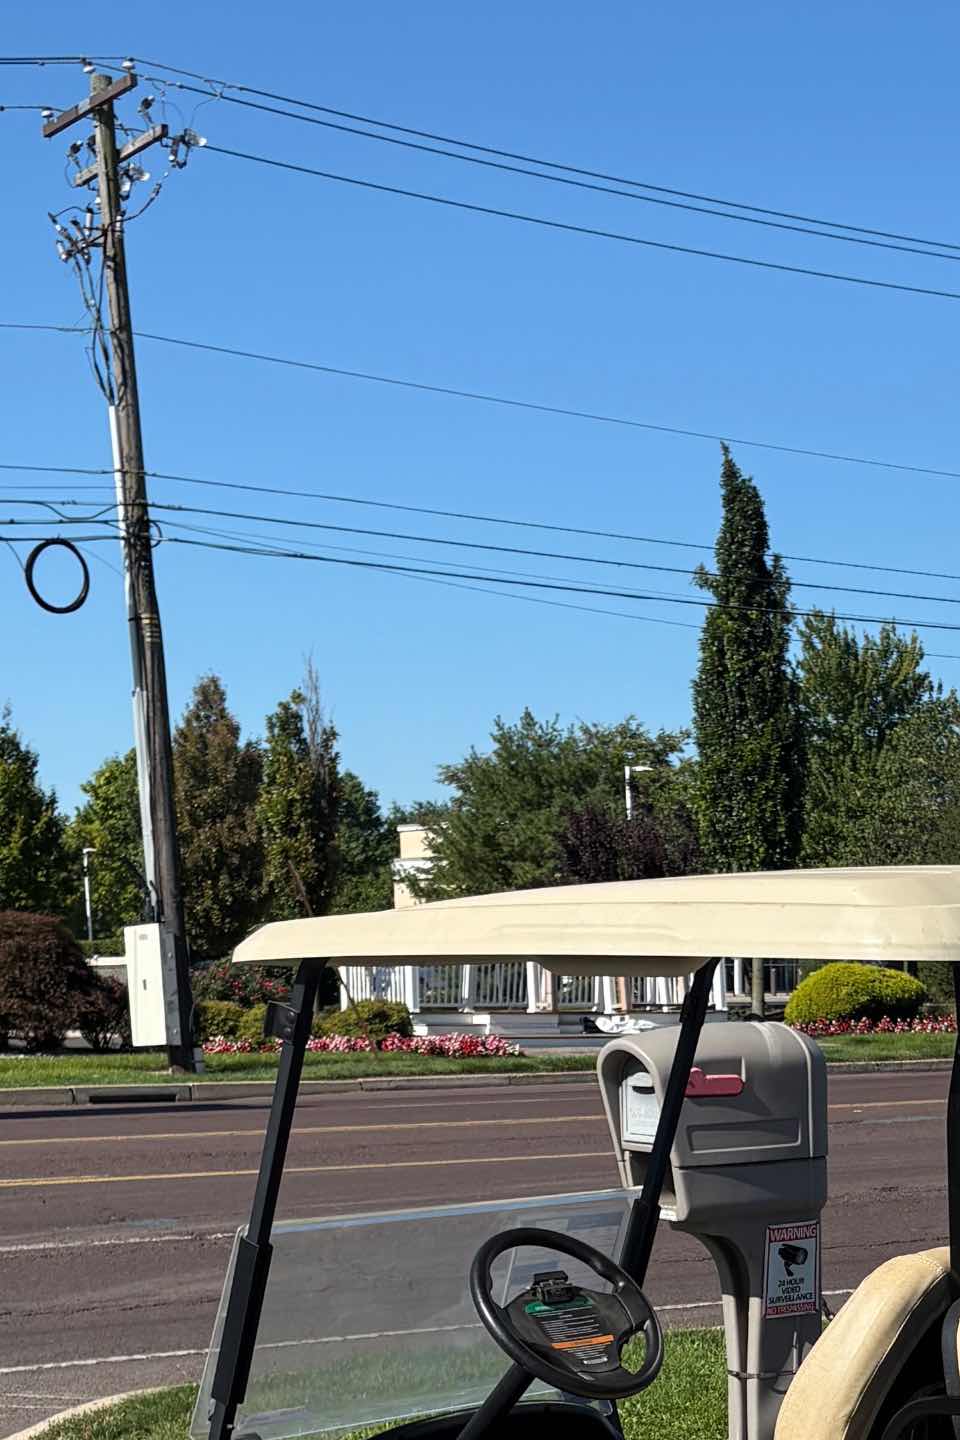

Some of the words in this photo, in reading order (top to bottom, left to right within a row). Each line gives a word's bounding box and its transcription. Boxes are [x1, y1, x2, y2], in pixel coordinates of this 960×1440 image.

[769, 1224, 817, 1241] WARNING
[786, 1277, 804, 1286] HOUR
[782, 1285, 802, 1295] VIDEO
